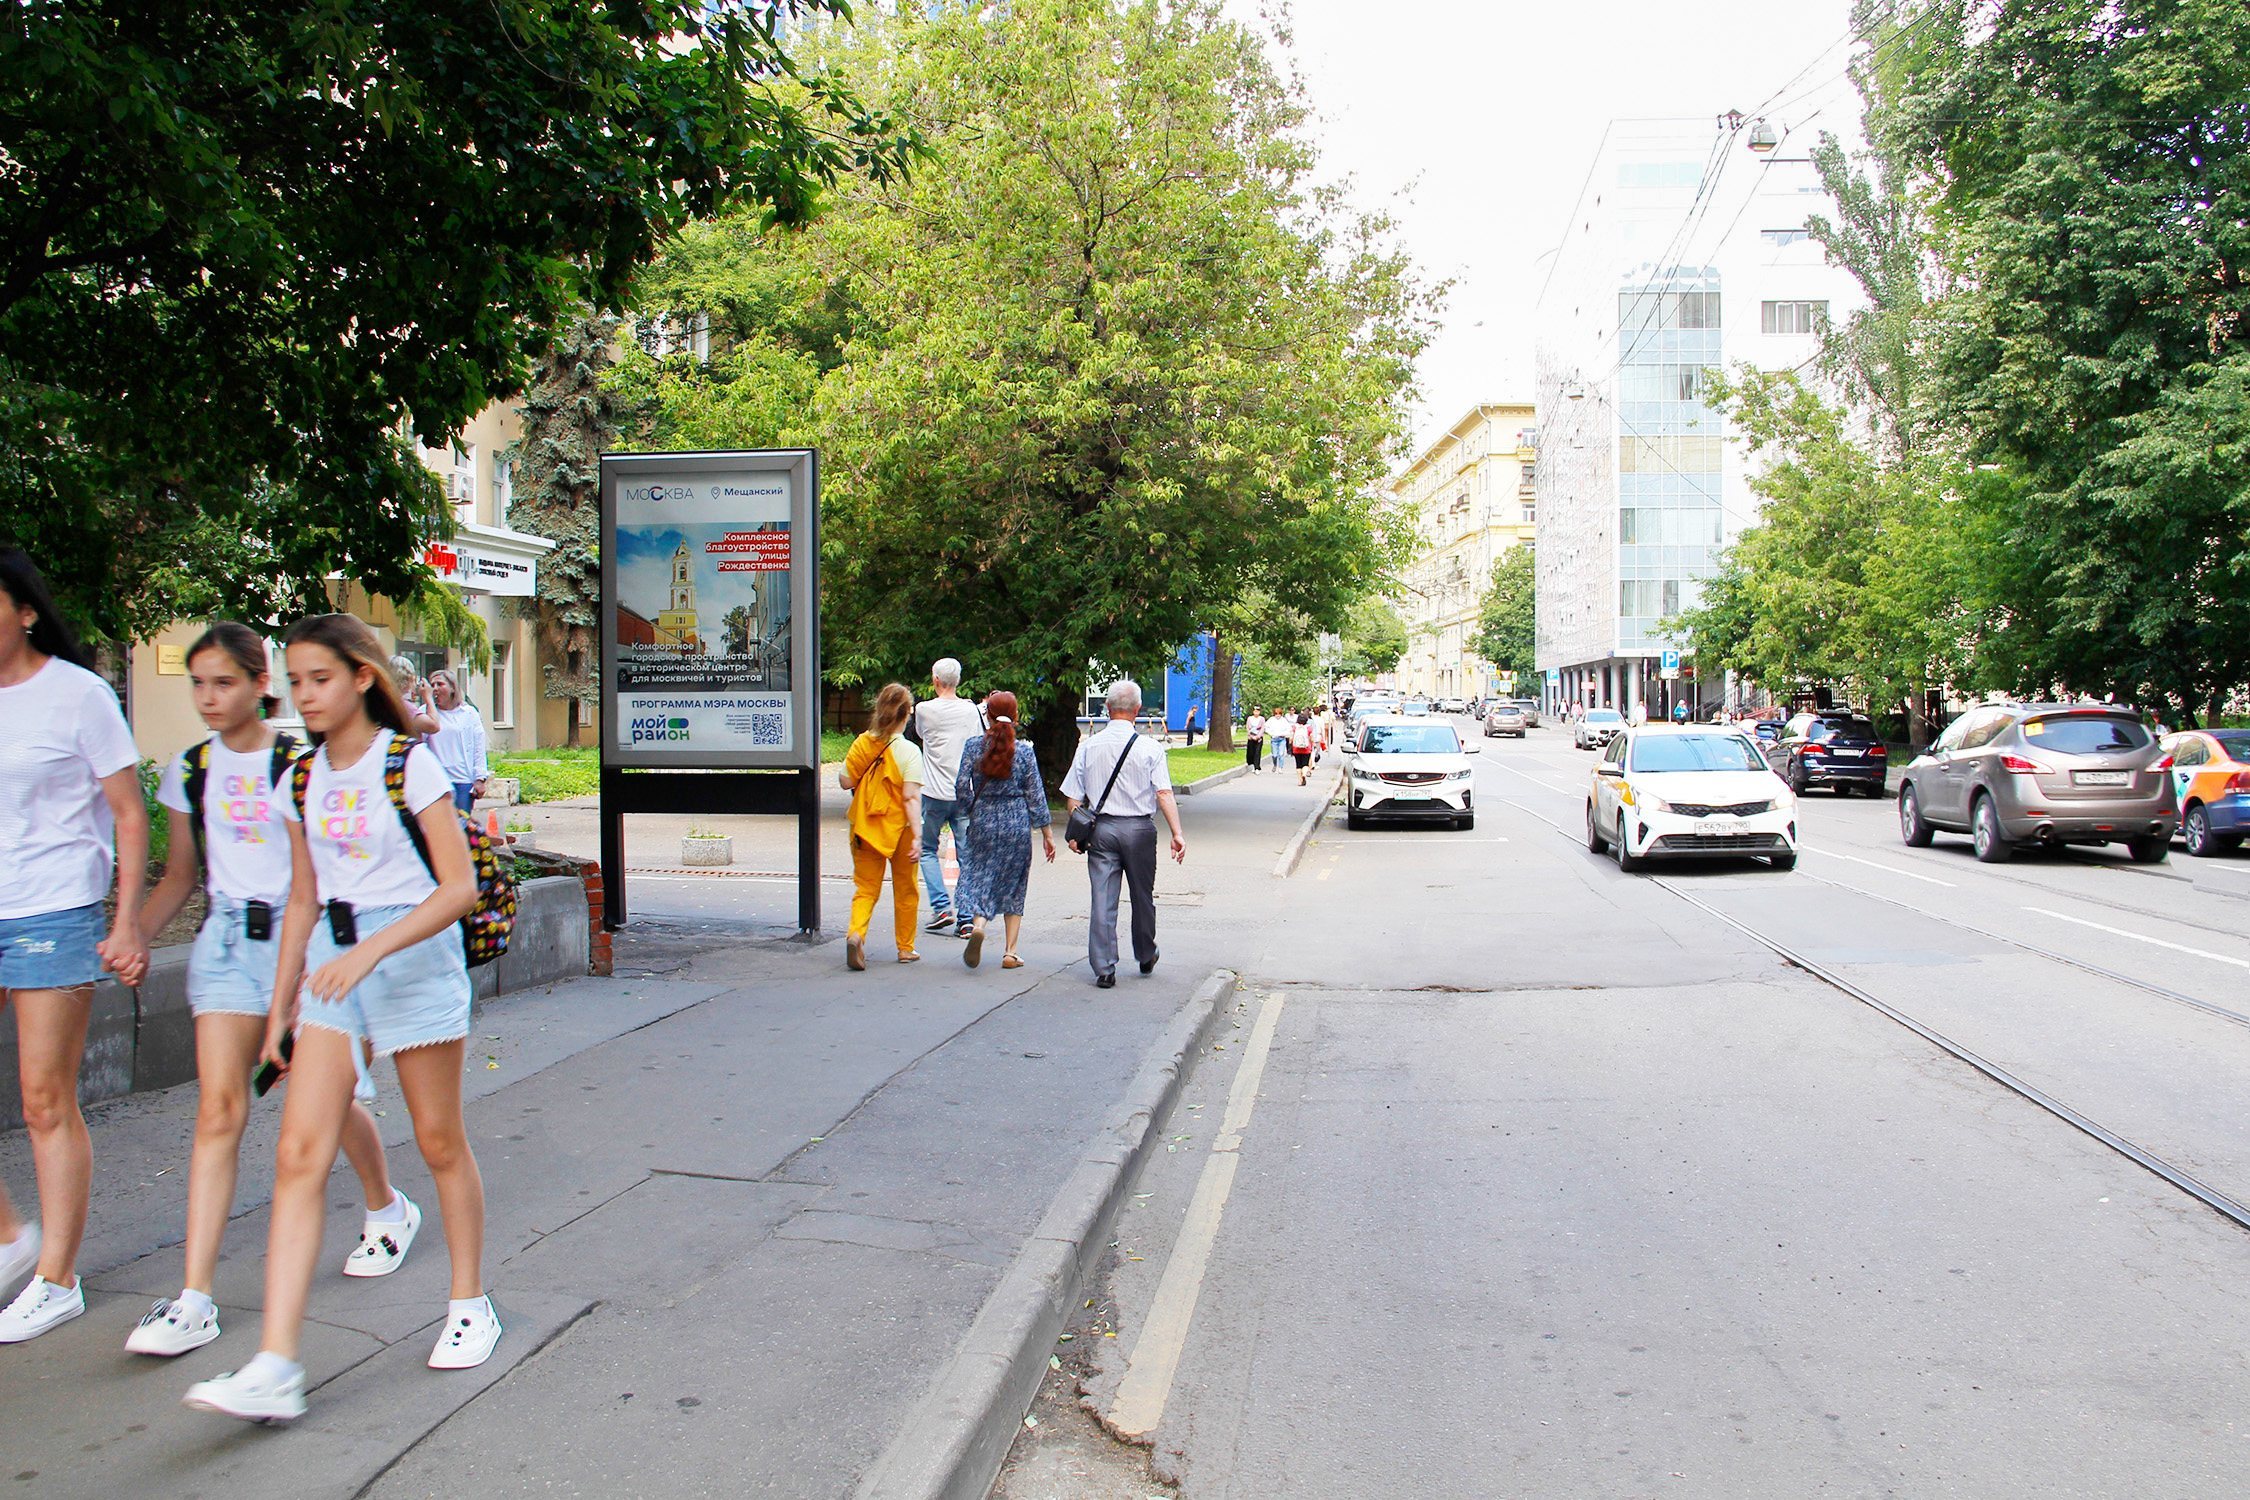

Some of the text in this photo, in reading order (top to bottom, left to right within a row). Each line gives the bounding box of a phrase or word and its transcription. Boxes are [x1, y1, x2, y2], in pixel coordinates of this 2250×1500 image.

[626, 486, 694, 501] МОСКВА
[724, 487, 784, 497] Мещанский
[724, 533, 790, 541] Комплексное
[705, 542, 790, 552] благоустройство
[759, 553, 790, 561] улицы
[718, 561, 790, 571] Рождественка
[631, 642, 694, 652] Комфортное
[631, 653, 754, 663] городское пространство
[640, 665, 710, 673] историческом
[711, 664, 748, 672] центре
[631, 676, 650, 684] для
[651, 674, 705, 683] москвичей
[715, 674, 763, 684] туристов
[631, 699, 787, 709] ПРОГРАММА МЭРА МОСКВЫ
[631, 714, 667, 729] мой
